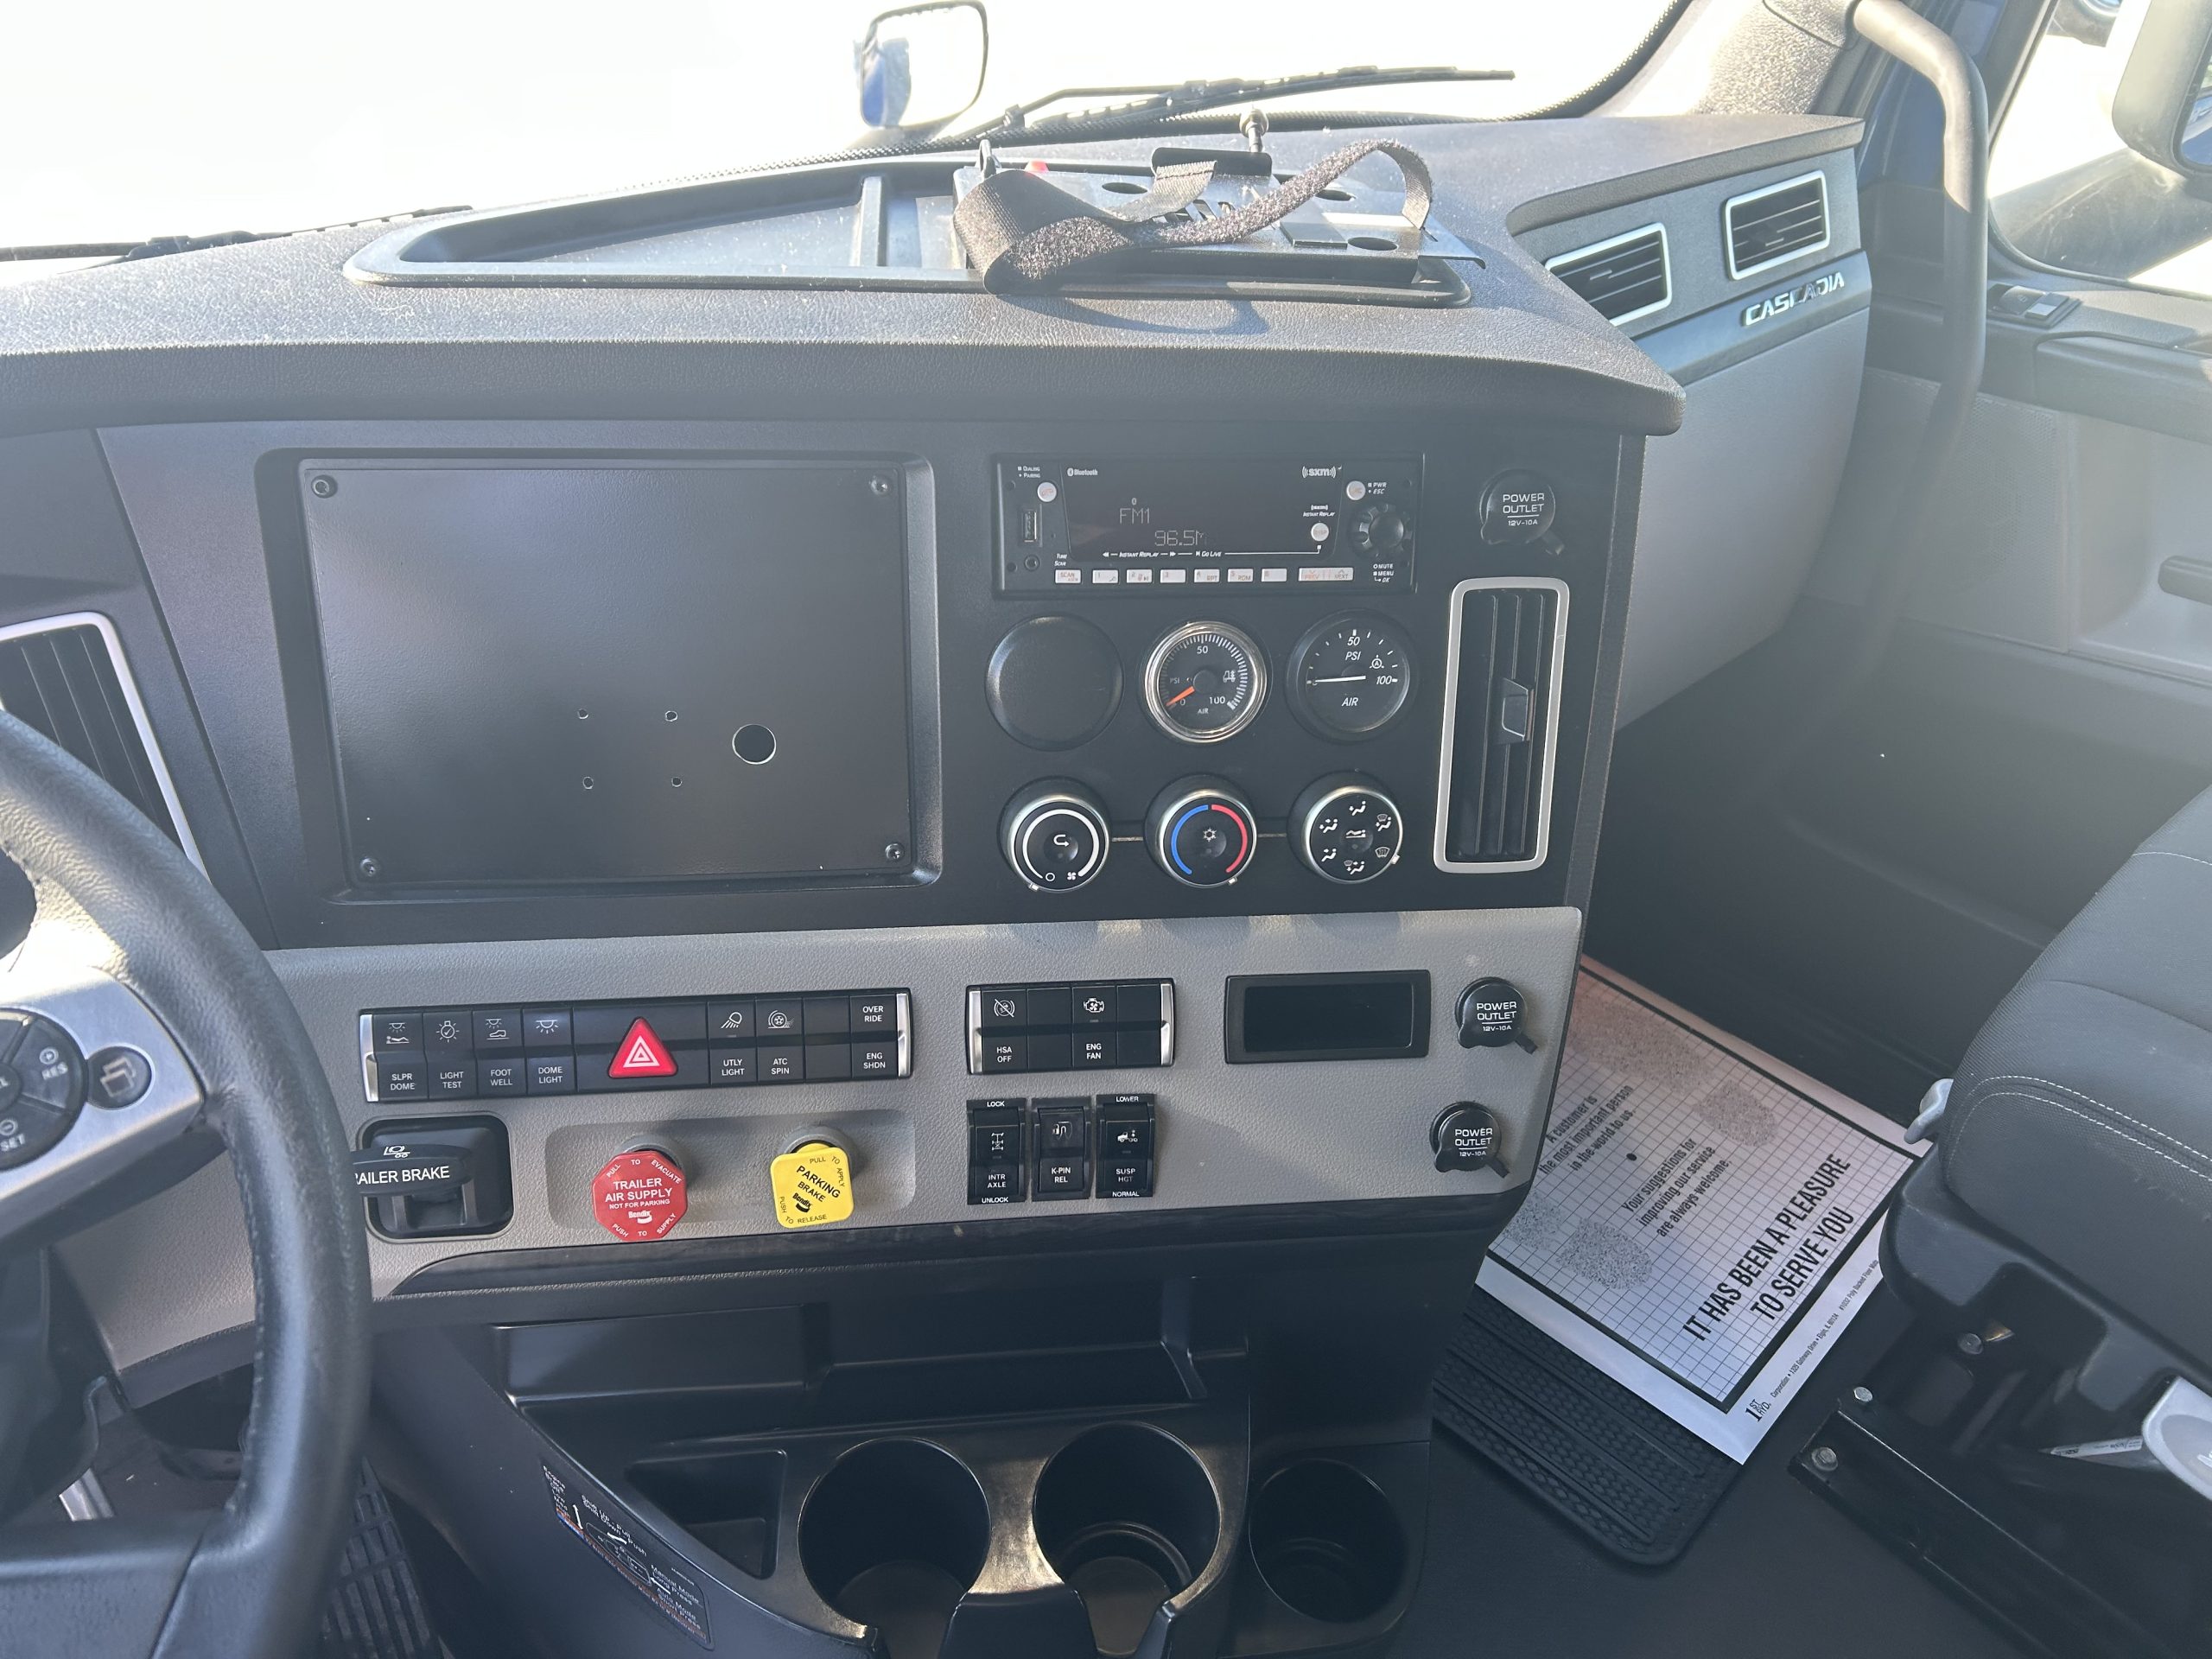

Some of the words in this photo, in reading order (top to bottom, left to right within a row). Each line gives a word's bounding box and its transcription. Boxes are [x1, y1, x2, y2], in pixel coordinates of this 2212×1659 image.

[1503, 493, 1545, 503] POWER
[1503, 503, 1545, 513] OUTLET
[1119, 507, 1150, 524] FM1
[1348, 636, 1360, 646] 50
[1197, 645, 1208, 654] 50
[1344, 652, 1362, 660] PSI
[1376, 676, 1393, 684] 100
[1342, 697, 1358, 707] AIR
[862, 1005, 885, 1014] OVER
[1476, 1001, 1517, 1011] POWER
[864, 1014, 883, 1023] RIDE
[1477, 1011, 1517, 1021] OUTLET
[996, 1046, 1013, 1054] HSA
[722, 1058, 743, 1067] UTLY
[863, 1061, 887, 1070] SHDN
[440, 1071, 464, 1080] LIGHT
[490, 1068, 512, 1077] FOOT
[537, 1066, 563, 1075] DOME
[721, 1068, 745, 1077] LIGHT
[771, 1066, 790, 1075] SPIN
[391, 1072, 413, 1081] SLPR
[490, 1078, 513, 1087] WELL
[1545, 1134, 1557, 1143] A
[1554, 1103, 1589, 1137] customer
[1584, 1096, 1598, 1106] is
[1454, 1128, 1493, 1137] POWER
[1538, 1160, 1556, 1175] the
[1553, 1141, 1576, 1162] most
[1569, 1107, 1611, 1146] important
[1606, 1085, 1633, 1111] person
[0, 1134, 26, 1151] SET
[1455, 1137, 1493, 1147] OUTLET
[1567, 1160, 1583, 1172] in
[1576, 1147, 1595, 1163] the
[1591, 1127, 1616, 1149] world
[1611, 1119, 1624, 1130] to
[354, 1170, 399, 1185] AILER
[402, 1166, 450, 1182] BRAKE
[607, 1163, 620, 1178] PULL
[651, 1160, 683, 1185] EVACUATE
[831, 1156, 840, 1165] TO
[836, 1167, 845, 1187] APPLY
[1051, 1166, 1071, 1175] K-PIN
[1621, 1193, 1645, 1211] Your
[1642, 1149, 1687, 1195] suggestions
[1680, 1138, 1697, 1152] for
[613, 1177, 662, 1191] TRAILER
[797, 1165, 842, 1198] PARKING
[987, 1180, 1007, 1189] AXLE
[1054, 1175, 1068, 1184] REL
[797, 1180, 826, 1203] BRAKE
[1636, 1185, 1681, 1227] improving
[1675, 1172, 1691, 1189] our
[1687, 1146, 1716, 1174] service
[605, 1192, 625, 1203] AIR
[627, 1187, 672, 1201] SUPPLY
[1775, 1154, 1851, 1230] PLEASURE
[639, 1198, 671, 1207] PARKING
[791, 1192, 812, 1209] Bendix
[982, 1196, 1009, 1205] UNLOCK
[627, 1210, 652, 1218] Bendix
[785, 1216, 794, 1224] TO
[797, 1213, 828, 1224] RELEASE
[1656, 1221, 1675, 1237] are
[1669, 1192, 1699, 1224] always
[612, 1224, 629, 1237] PUSH
[657, 1213, 676, 1234] SUPPLY
[1764, 1227, 1790, 1246] A
[1728, 1239, 1778, 1287] BEEN
[1750, 1293, 1785, 1320] TO
[1771, 1237, 1828, 1298] SERVE
[1813, 1206, 1854, 1243] YOU
[1699, 1282, 1742, 1322] HAS
[1682, 1314, 1712, 1341] IT
[1770, 1376, 1789, 1398] Corporation
[1796, 1349, 1813, 1366] Gateway
[1808, 1340, 1819, 1351] Drive
[678, 1586, 699, 1604] Mode
